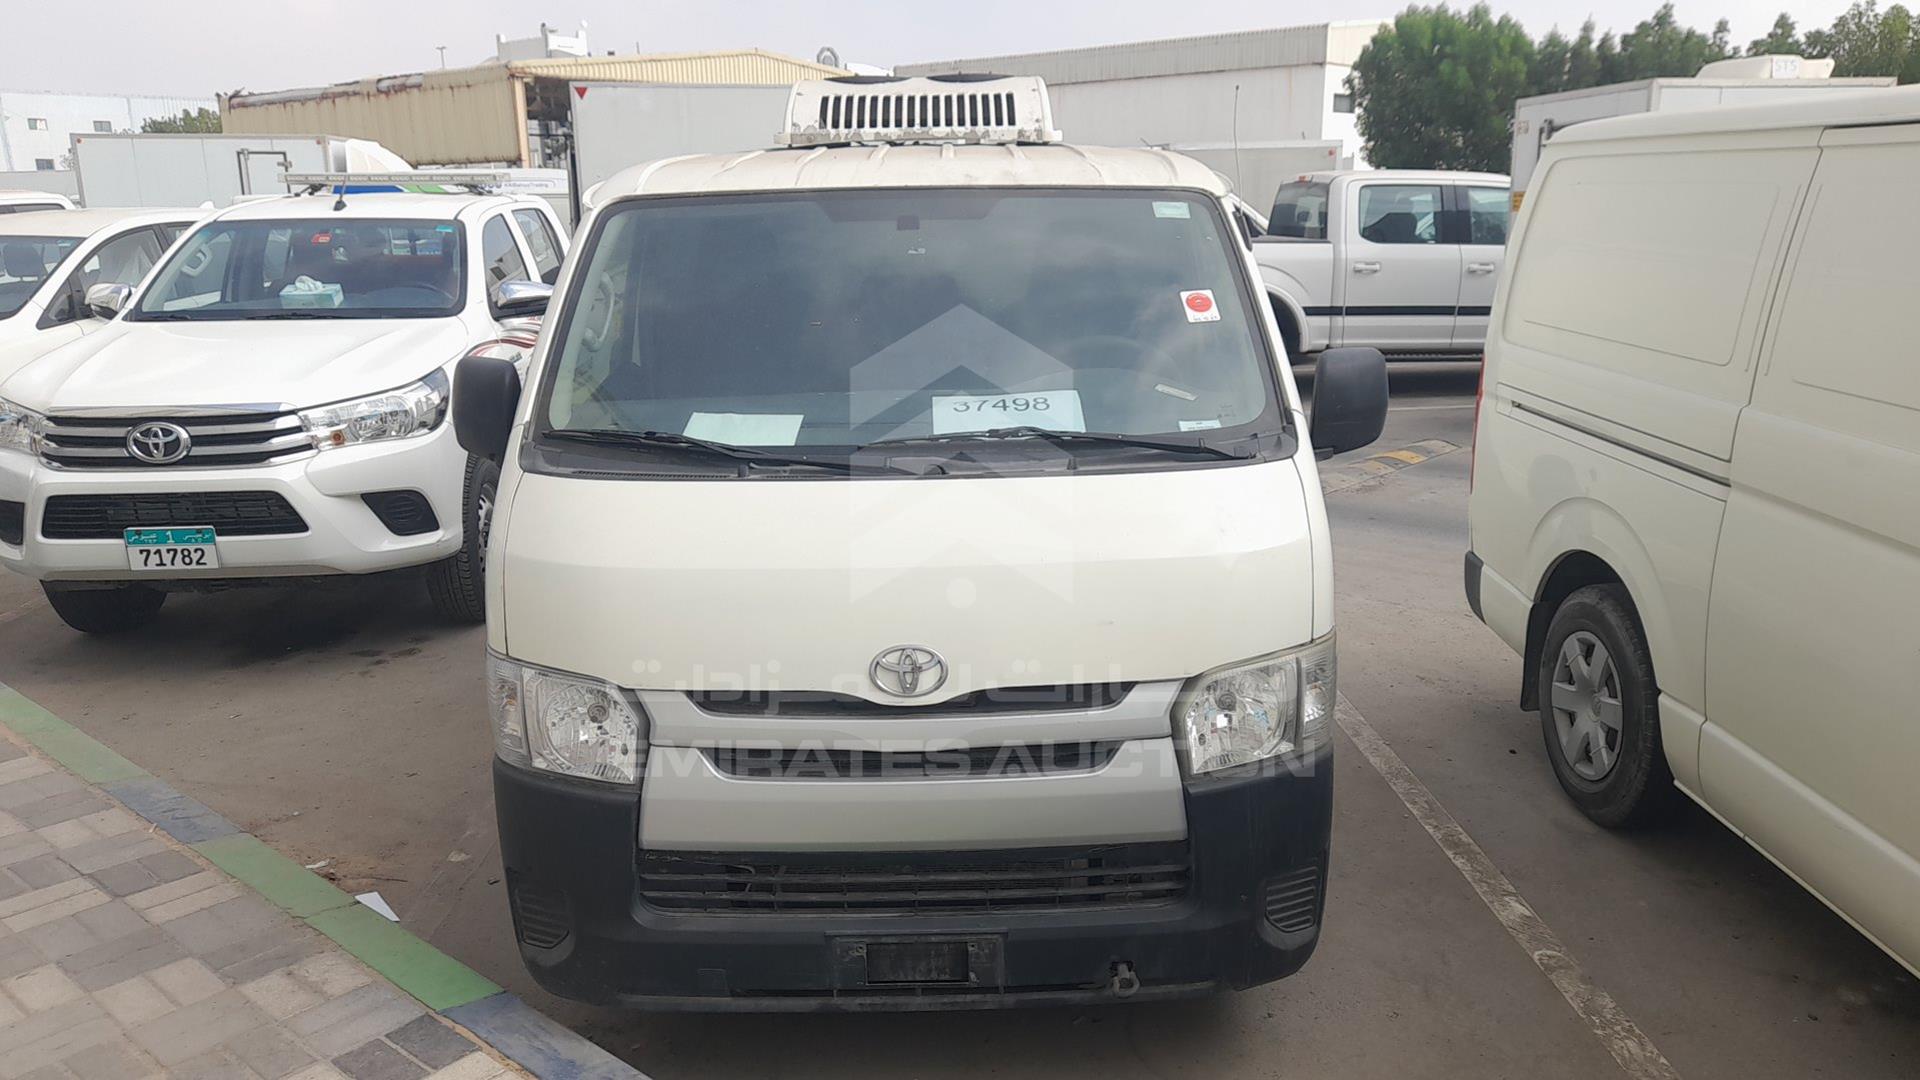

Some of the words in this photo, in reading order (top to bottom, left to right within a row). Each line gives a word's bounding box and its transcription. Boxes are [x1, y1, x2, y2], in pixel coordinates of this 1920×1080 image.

[952, 397, 1050, 413] 37498
[166, 530, 176, 543] 1
[138, 547, 208, 568] 71782
